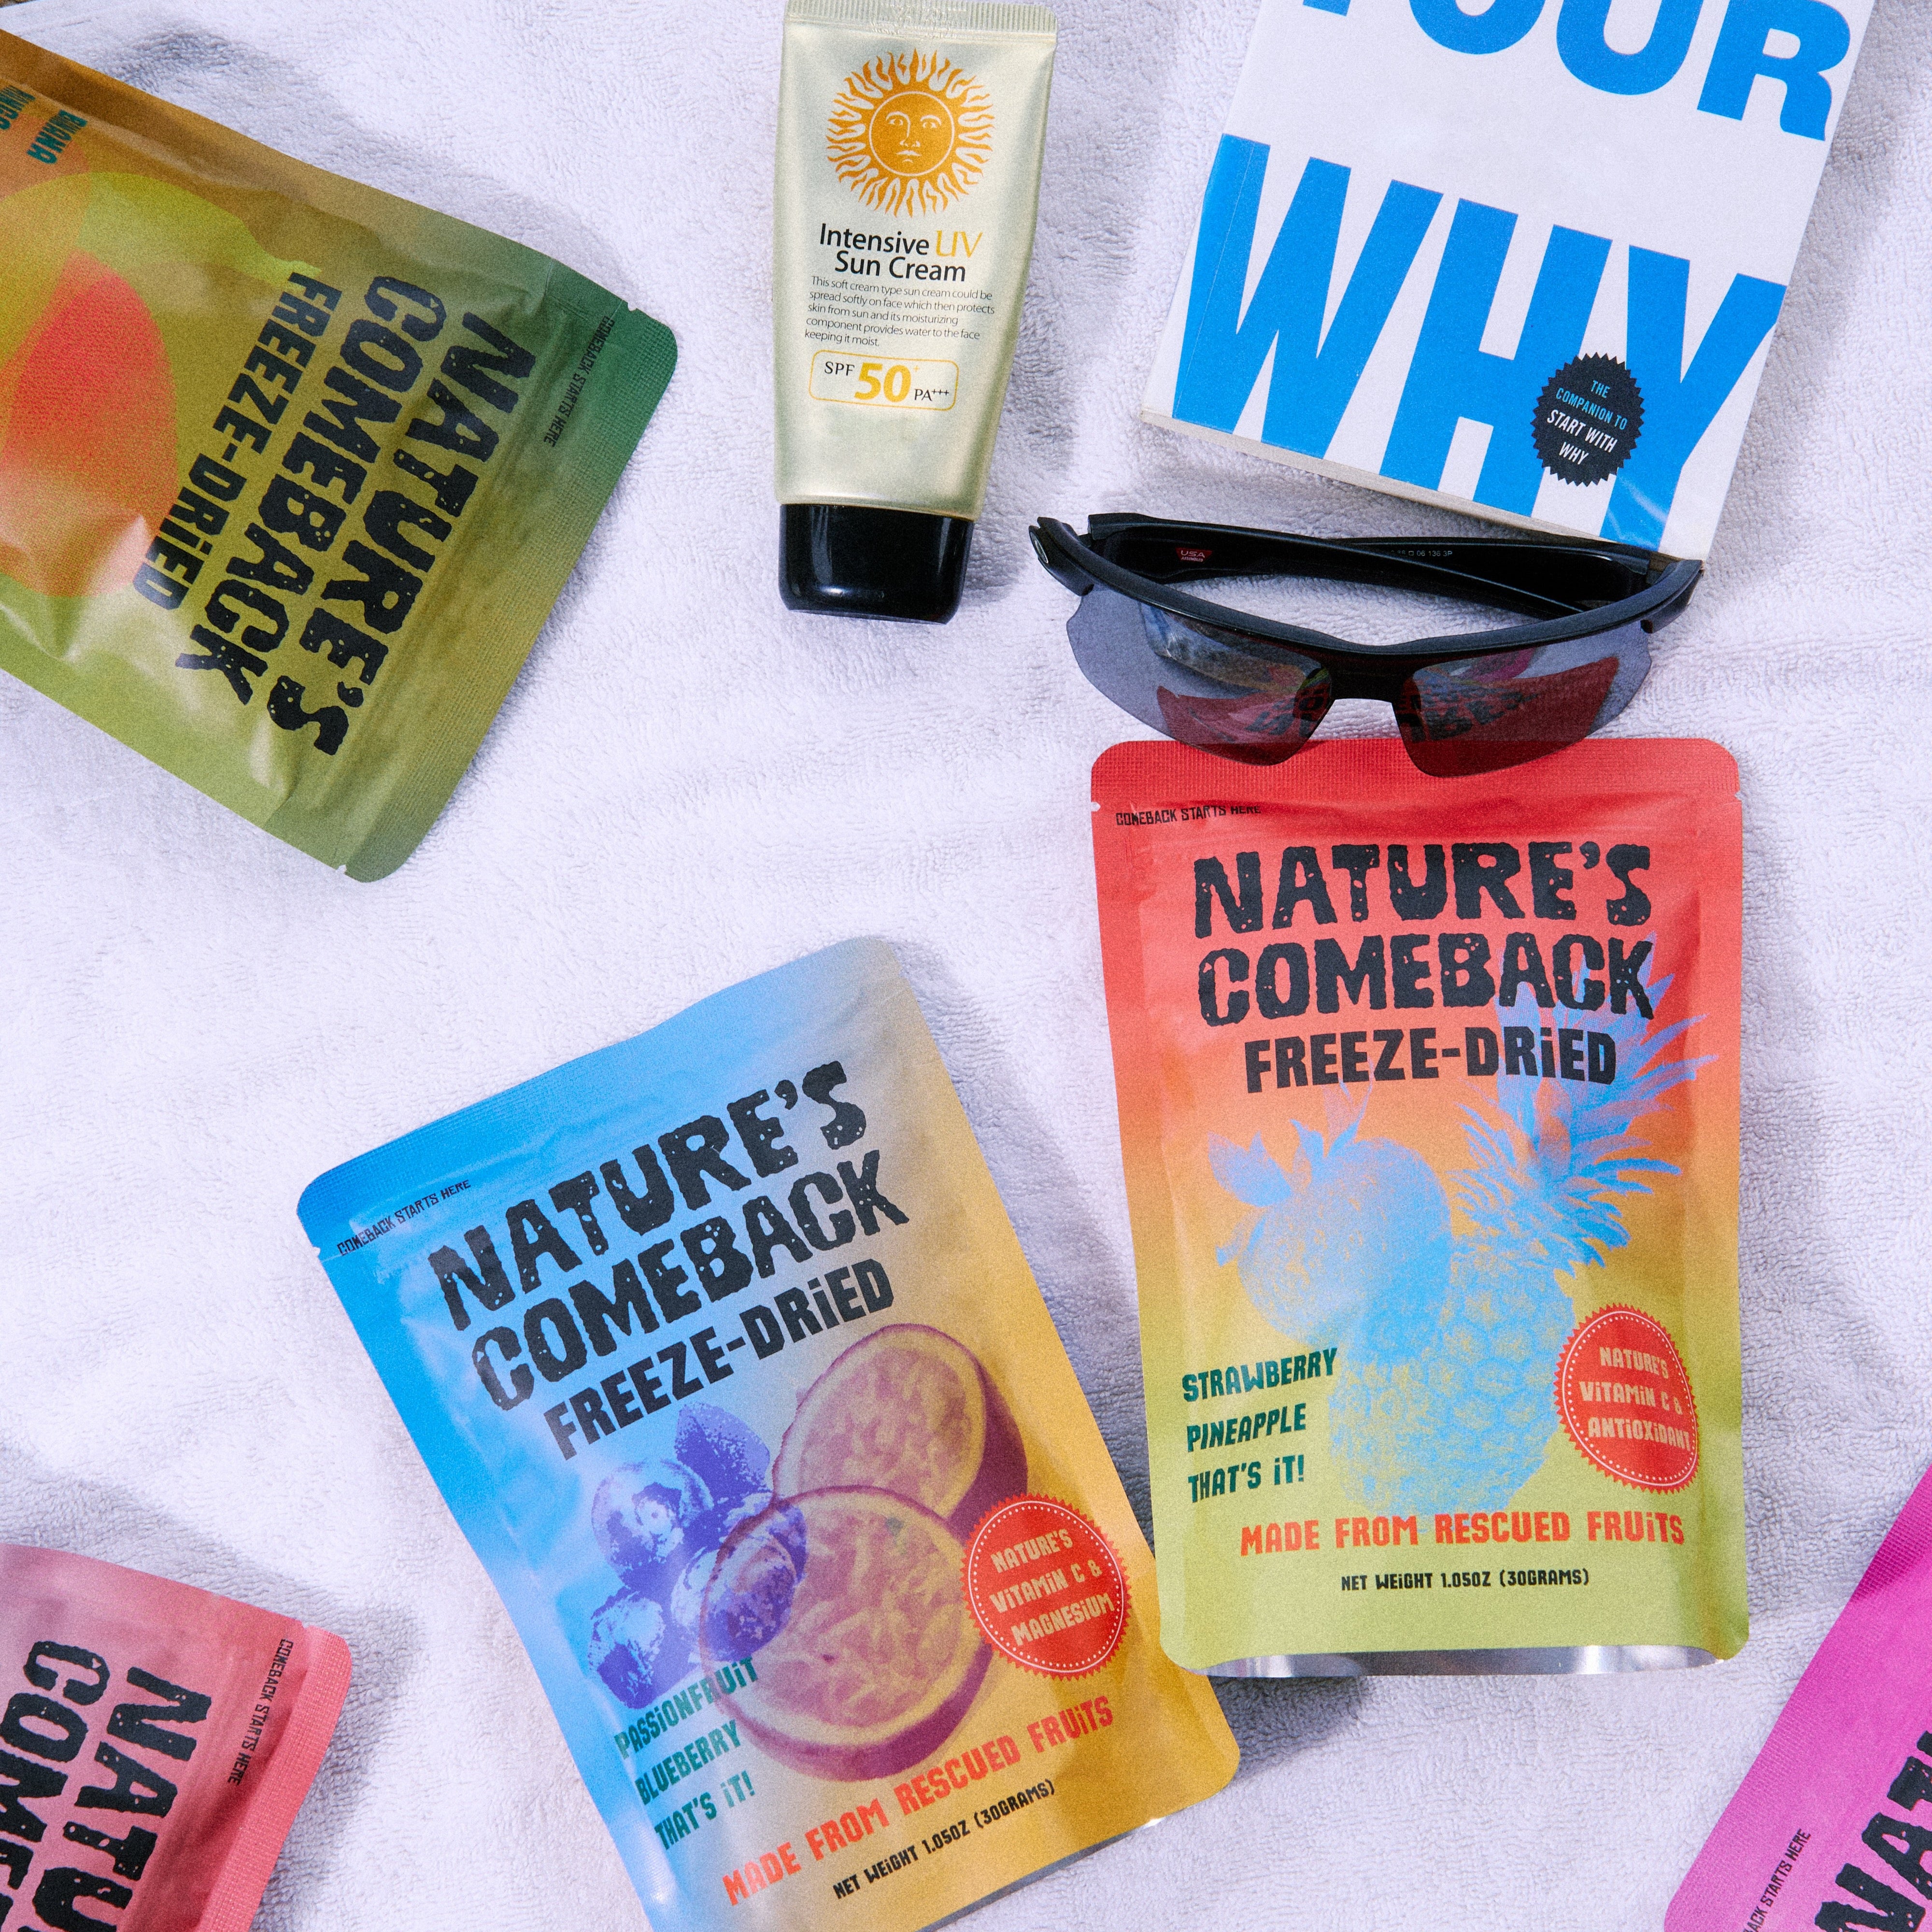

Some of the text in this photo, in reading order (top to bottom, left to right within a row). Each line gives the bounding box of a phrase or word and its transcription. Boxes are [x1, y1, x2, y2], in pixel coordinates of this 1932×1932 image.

[820, 223, 983, 258] Intensive UV
[811, 276, 829, 287] This
[831, 278, 848, 289] soft
[850, 283, 879, 293] cream
[881, 285, 902, 297] type
[922, 289, 950, 298] cream
[952, 289, 978, 299] could
[980, 290, 993, 300] be
[835, 250, 966, 282] Sun Cream
[808, 303, 958, 327] skin from sun and its moisturizing
[810, 290, 995, 314] spread softly on face which then protects
[805, 329, 880, 346] keeping it moist.
[806, 317, 980, 340] component provides water to the face
[1172, 133, 1787, 553] WHY
[543, 315, 615, 447] COMEBACK STARTS HERE
[824, 362, 855, 376] SPF
[914, 388, 950, 401] PA+++
[1591, 380, 1610, 398] THE
[1556, 388, 1628, 430] COMPANION TO
[1547, 410, 1618, 453] START WITH
[1559, 441, 1589, 465] WHY
[175, 276, 447, 705] COMEBACK
[267, 312, 536, 755] NATURE'S
[1116, 805, 1261, 825] COMEBACK STARTS HERE
[1194, 841, 1652, 938] NATURE'S
[1198, 932, 1654, 1026] COMEBACK
[337, 1179, 471, 1256] COMEBACK STARTS HERE
[427, 1061, 867, 1331] NATURE'S
[471, 1149, 910, 1411] COMEBACK
[1182, 1348, 1337, 1402] STRAWBERRY
[1599, 1347, 1668, 1379] NATURE'S
[1661, 1391, 1670, 1411] C
[1674, 1397, 1683, 1415] &
[1187, 1402, 1306, 1452] PINEAPPLE
[1188, 1461, 1261, 1503] THAT'S
[991, 1529, 1073, 1573] NATURE'S
[1241, 1520, 1320, 1556] MADE
[1335, 1515, 1419, 1548] FROM
[1435, 1511, 1570, 1545] RESCUED
[1070, 1563, 1085, 1583] C
[1087, 1560, 1102, 1577] &
[1341, 1575, 1367, 1591] NET
[1500, 1568, 1589, 1587] (30GRAMS)
[227, 1638, 294, 1786] COMEBACK STARTS HERE
[635, 1719, 740, 1805] BLUEBERRY
[18, 1667, 212, 1932] NATU
[654, 1791, 717, 1850] THAT'S
[722, 1842, 802, 1906] MADE
[805, 1798, 890, 1861] FROM
[893, 1734, 1022, 1817] RESCUED
[833, 1874, 861, 1899] NET
[974, 1778, 1055, 1828] (30GRAMS)
[1760, 1860, 1792, 1907] STARTS
[1785, 1828, 1811, 1861] HERE
